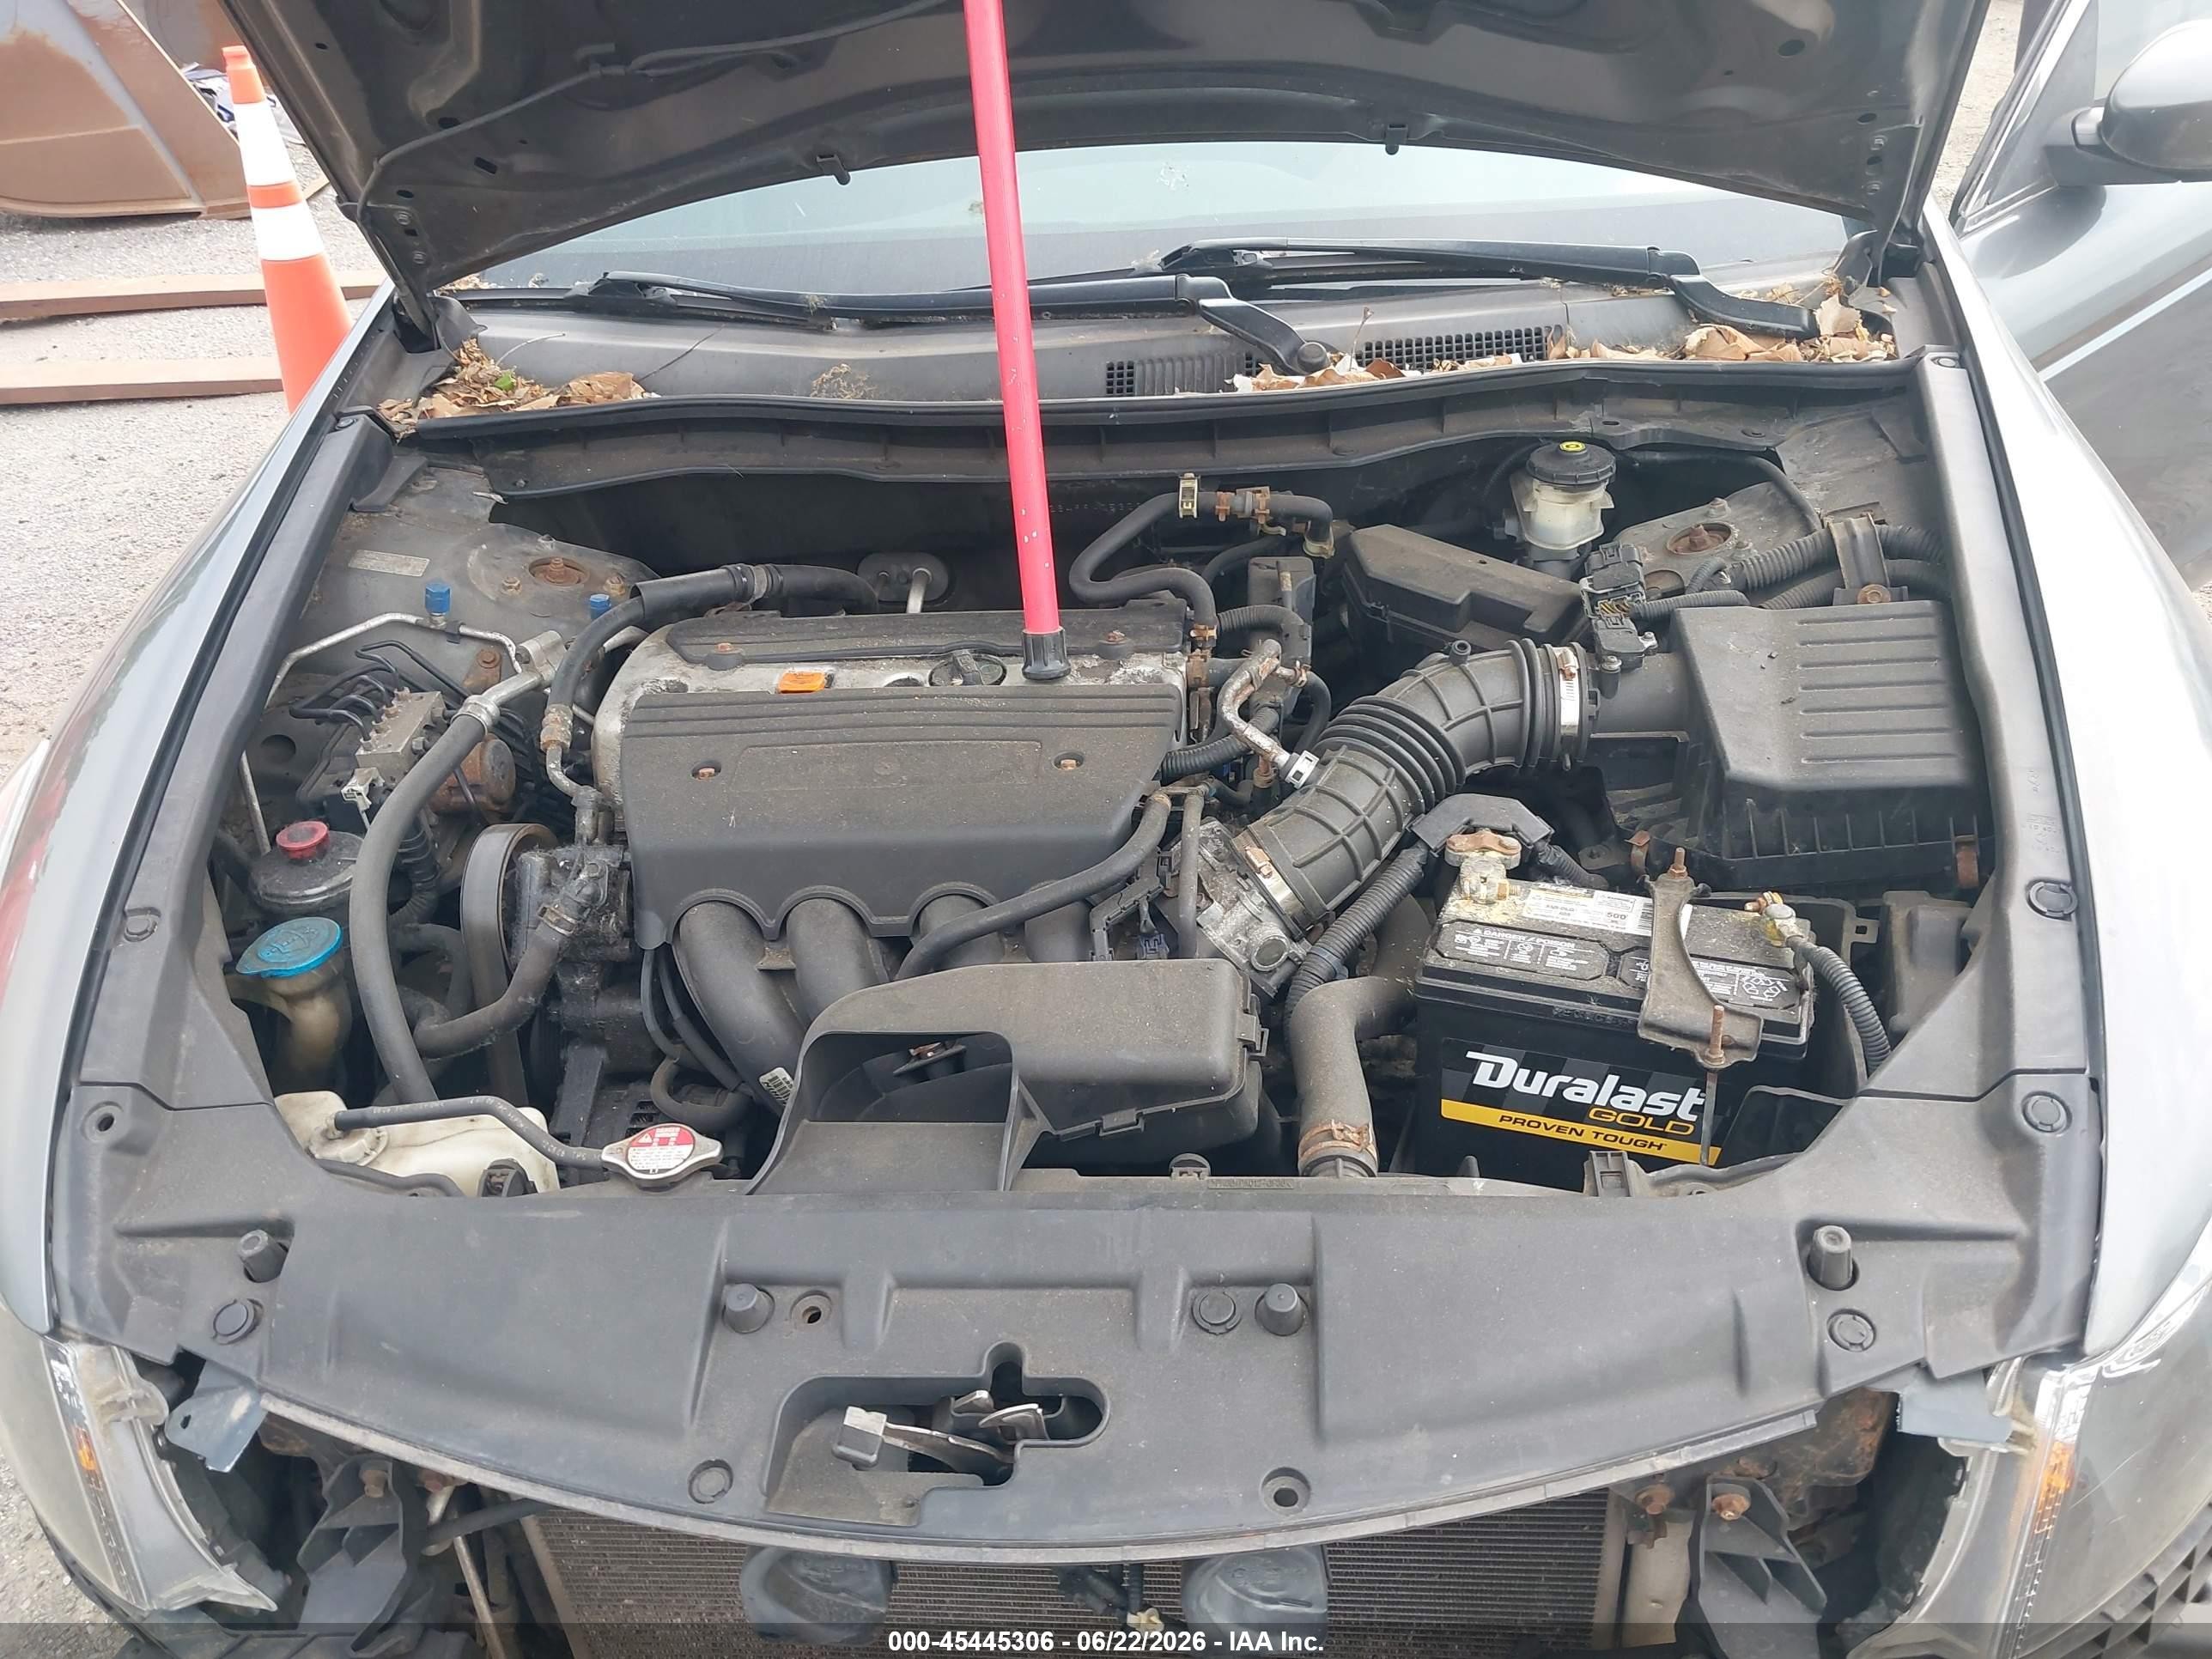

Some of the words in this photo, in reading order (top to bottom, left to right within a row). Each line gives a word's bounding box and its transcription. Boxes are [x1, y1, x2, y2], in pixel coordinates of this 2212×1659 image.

[1483, 930, 1525, 941] DANGER
[1535, 938, 1576, 948] POISON
[1466, 1051, 1705, 1121] Duralast
[1498, 1115, 1584, 1136] PROVEN
[1592, 1132, 1663, 1151] TOUGH
[1589, 1107, 1695, 1135] GOLD
